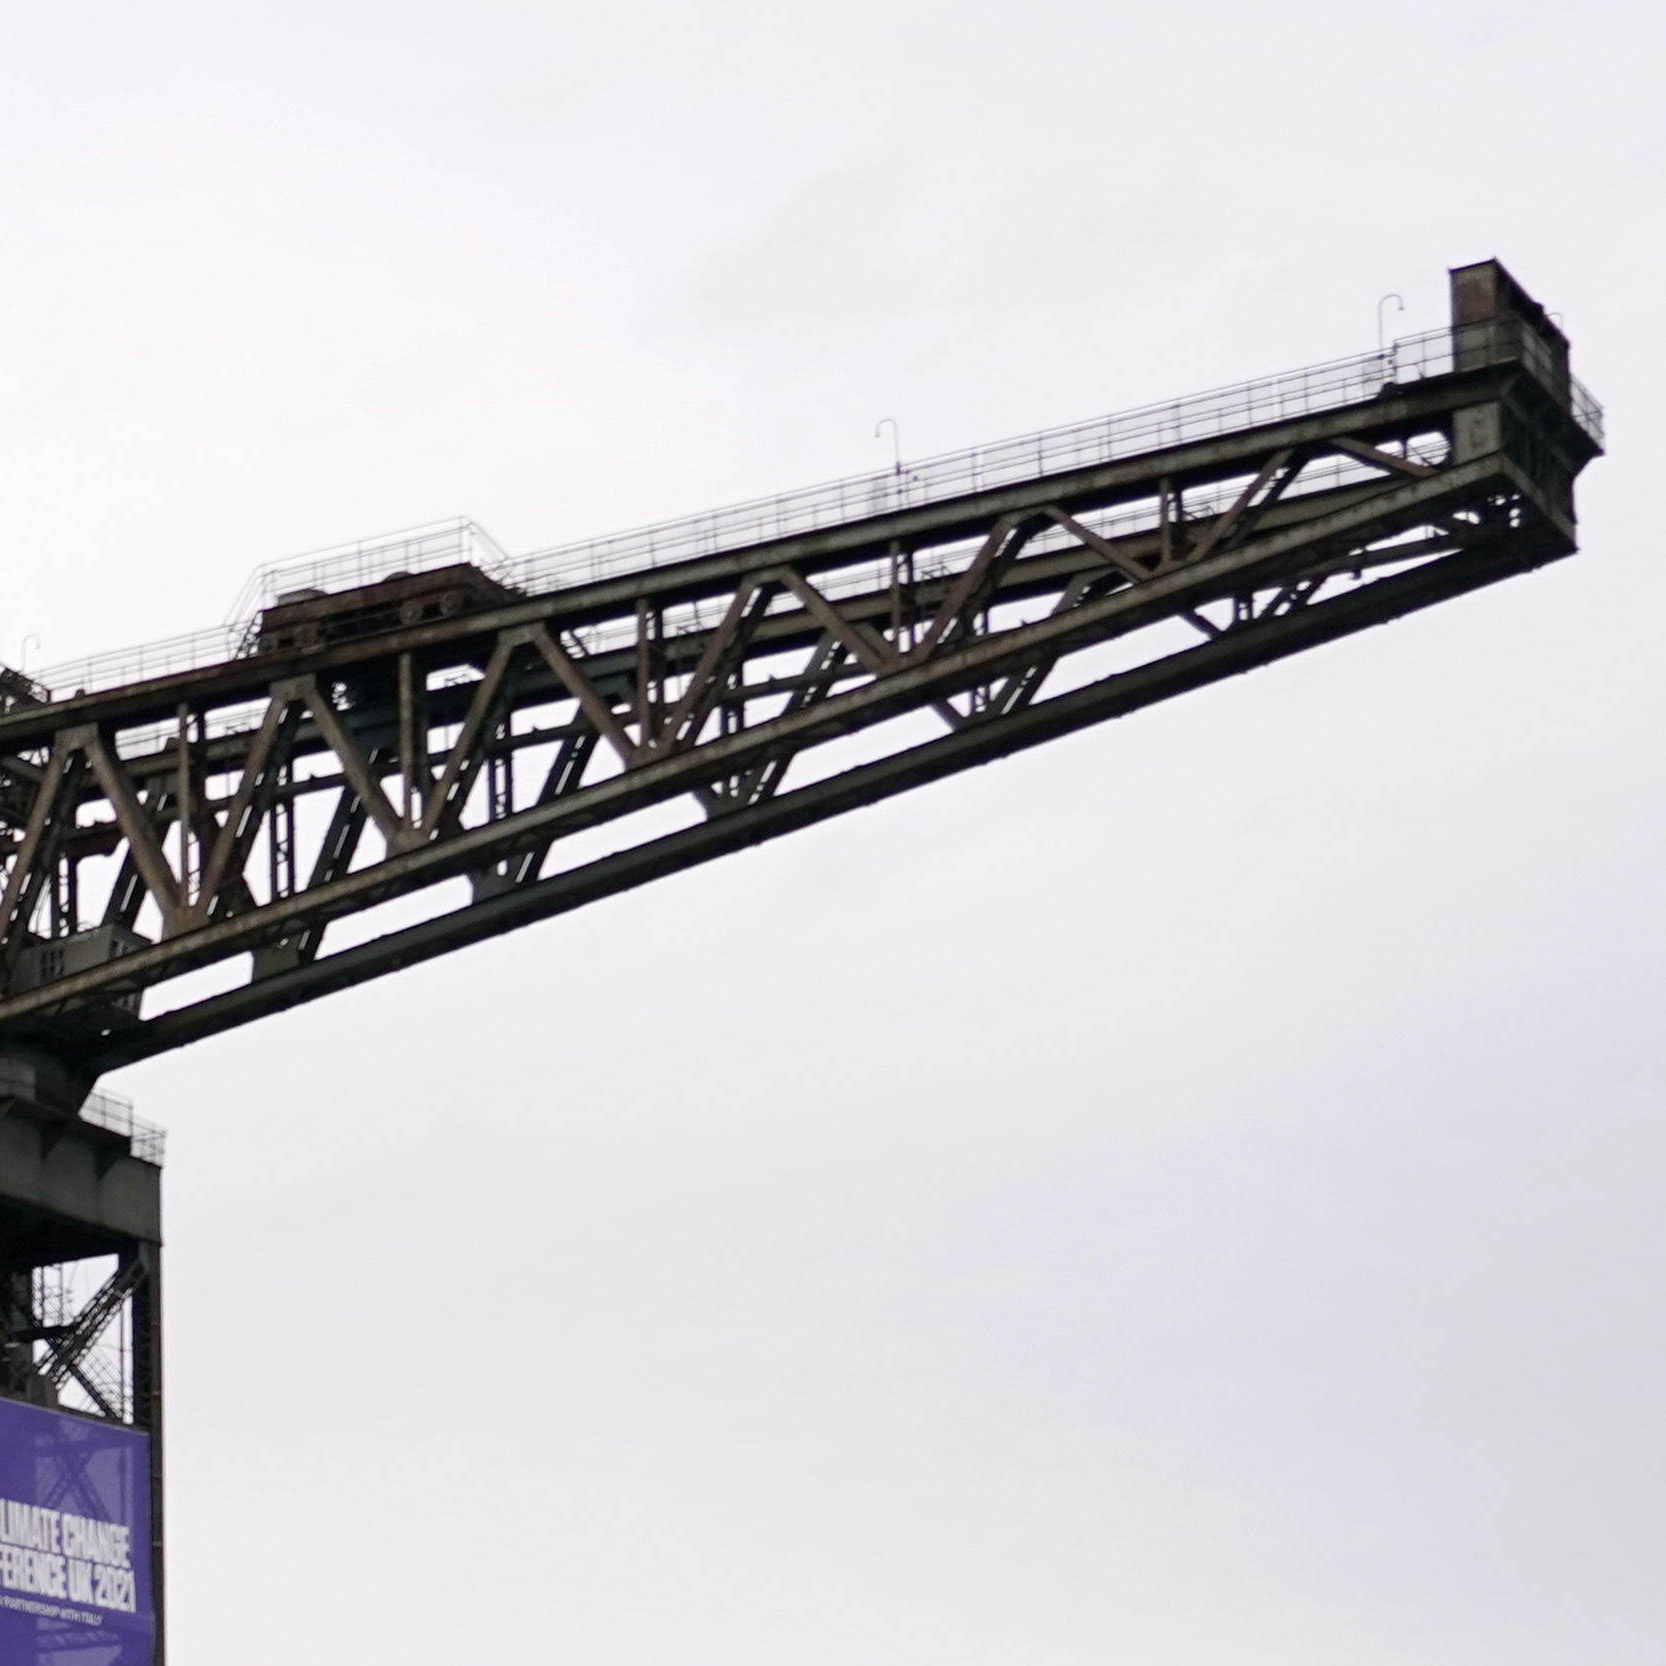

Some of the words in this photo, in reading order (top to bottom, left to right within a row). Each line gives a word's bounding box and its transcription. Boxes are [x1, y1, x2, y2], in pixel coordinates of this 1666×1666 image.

[62, 1513, 132, 1569] CHANGE
[68, 1557, 94, 1604] UK
[94, 1563, 136, 1613] 2021
